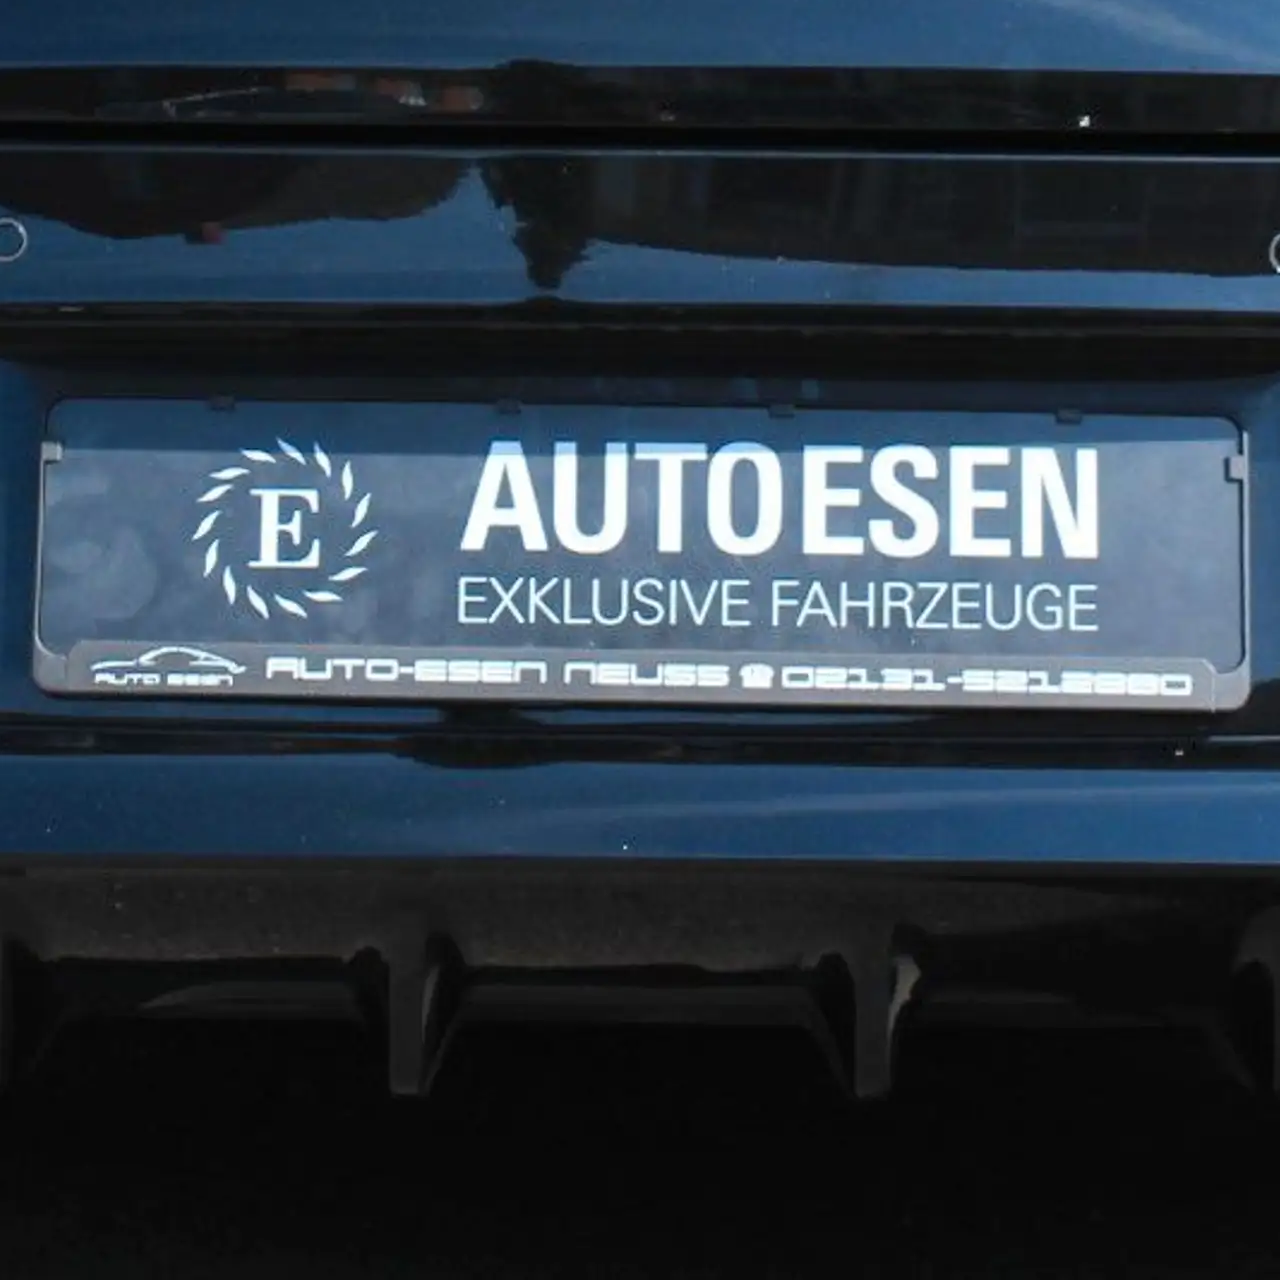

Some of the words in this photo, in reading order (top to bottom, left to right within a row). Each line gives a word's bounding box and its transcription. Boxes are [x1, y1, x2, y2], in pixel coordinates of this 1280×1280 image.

[248, 488, 320, 568] E
[457, 576, 751, 627] EXKLUSIVE
[771, 579, 1100, 632] FAHRZEUGE
[94, 672, 161, 687] AUTO
[265, 656, 549, 685] AUTO-ESEN
[563, 660, 731, 688] NEUSS
